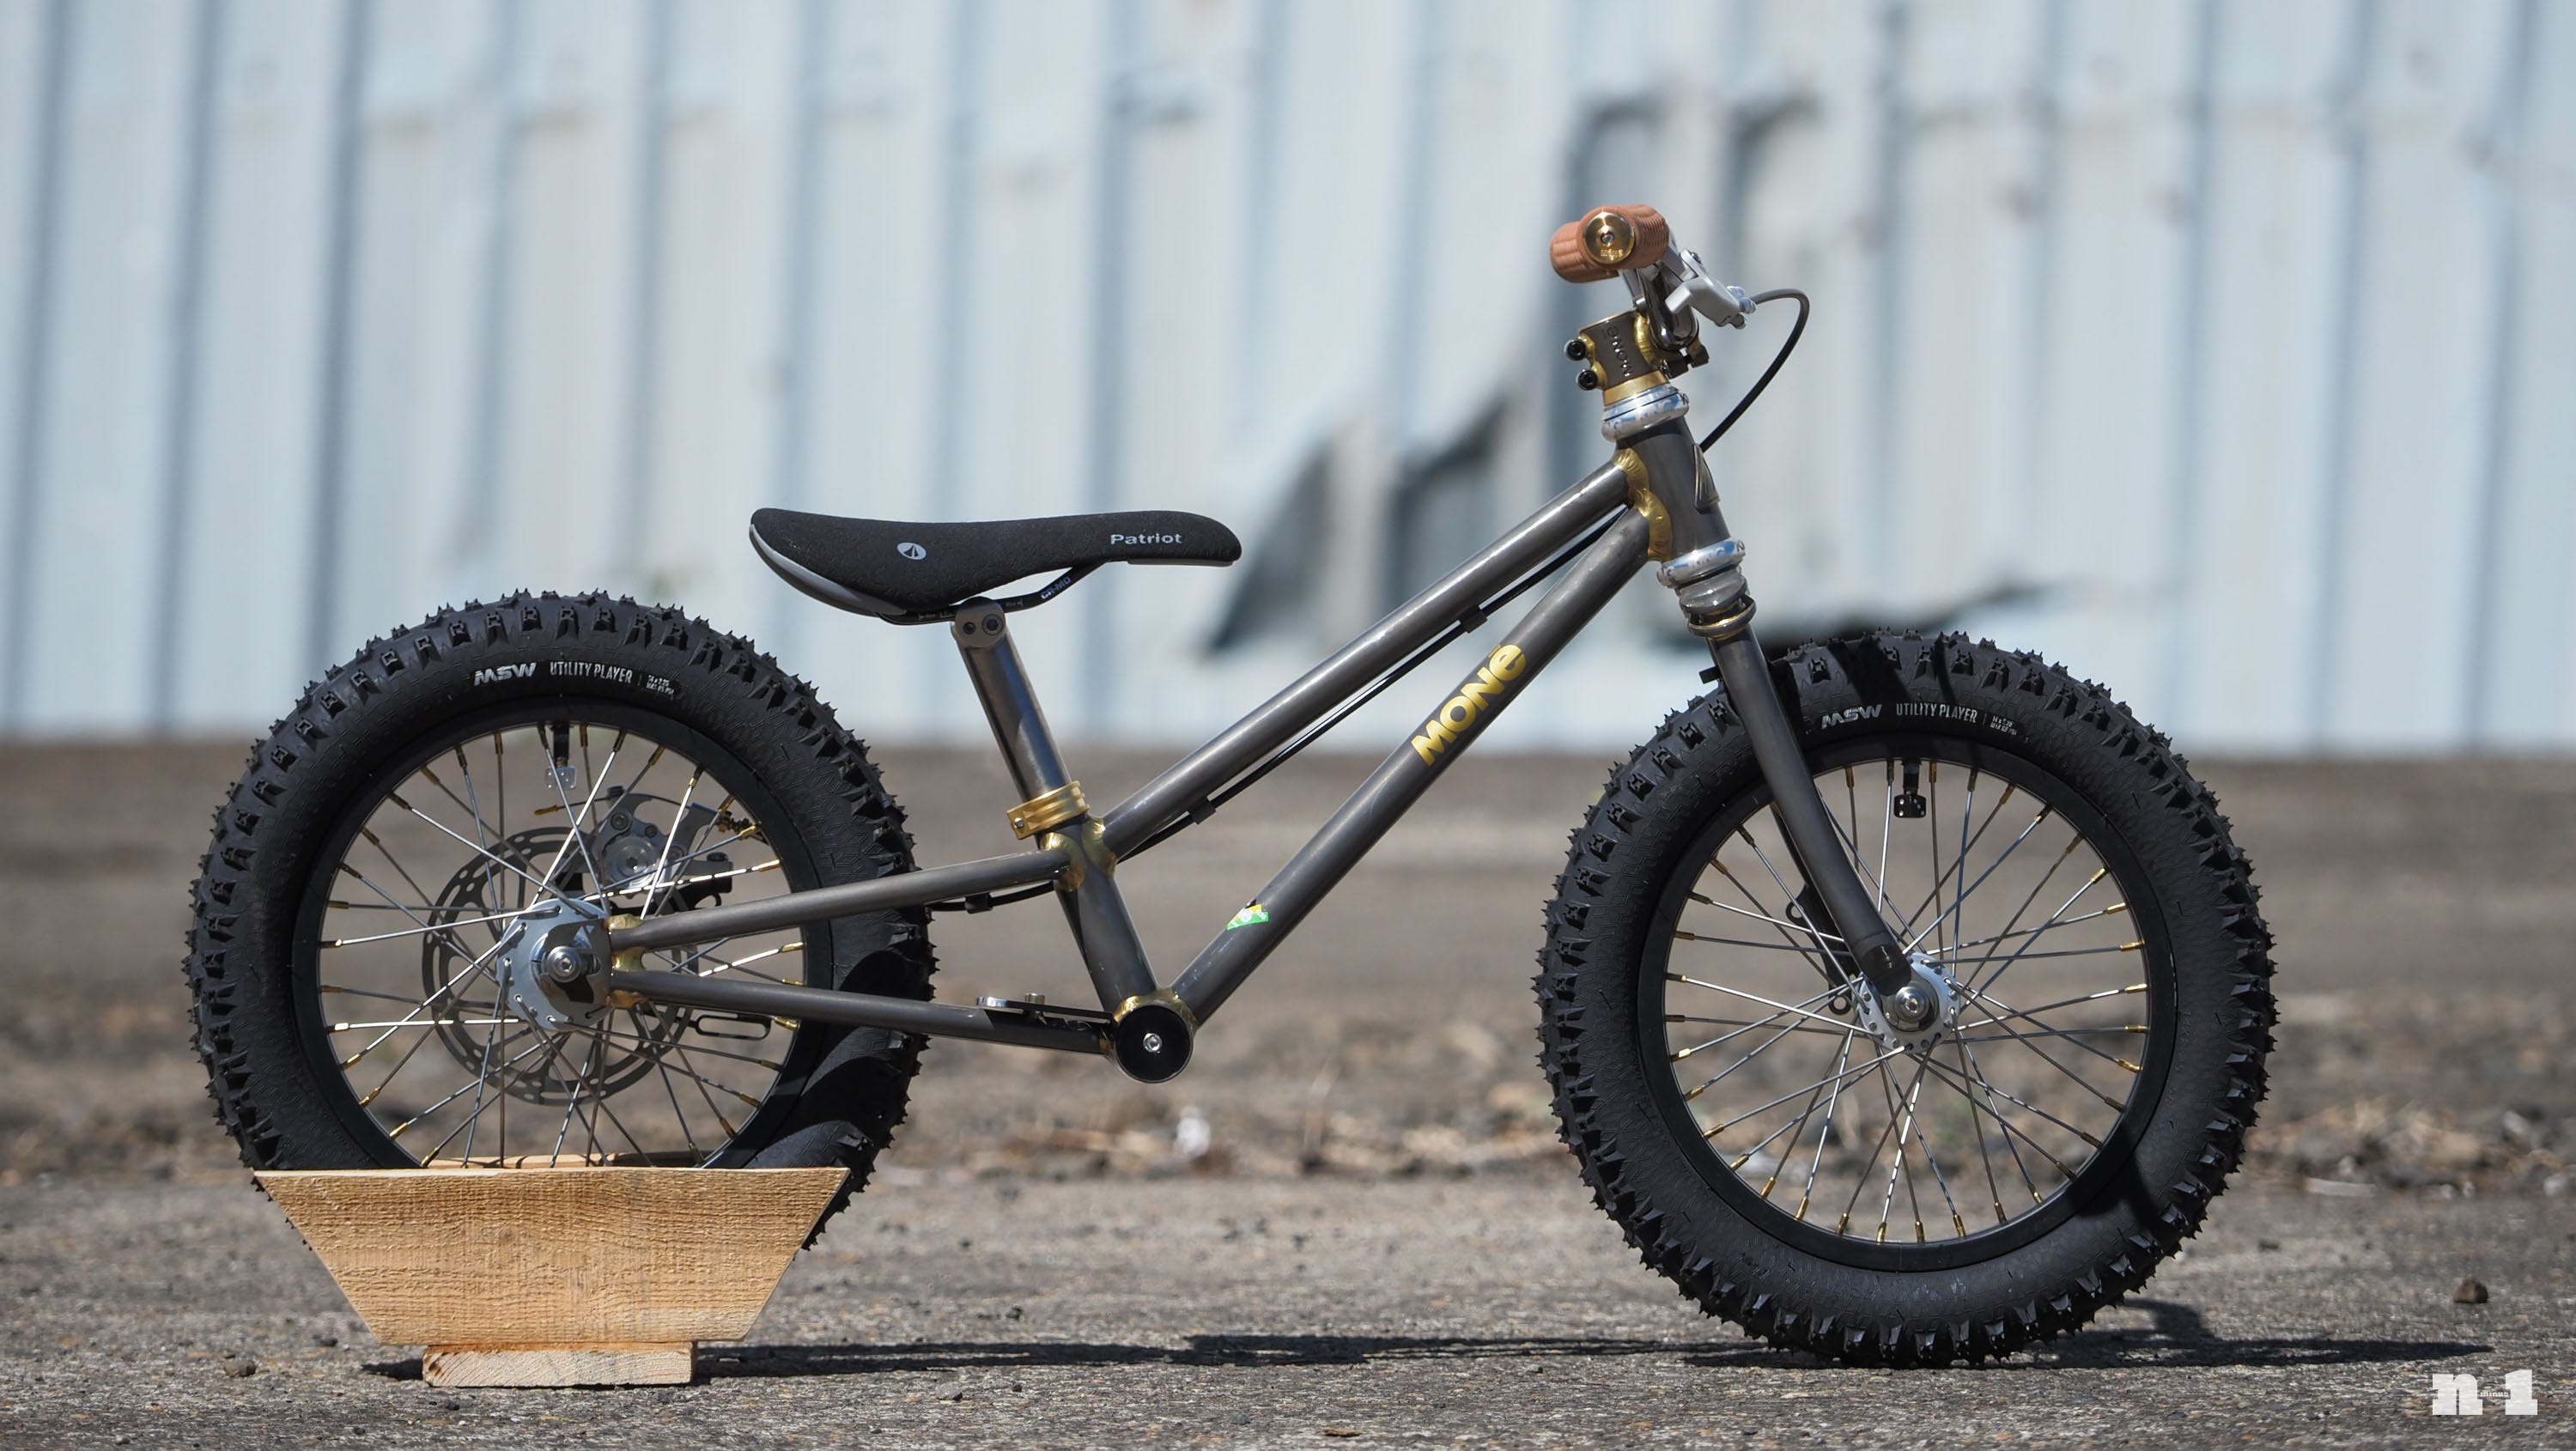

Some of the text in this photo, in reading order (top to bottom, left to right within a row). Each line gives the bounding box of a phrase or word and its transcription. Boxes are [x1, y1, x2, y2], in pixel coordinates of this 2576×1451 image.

[1110, 532, 1182, 545] Patriot
[1040, 576, 1072, 600] CR-MO
[473, 661, 633, 687] MSW UTILITY PLAYER
[1821, 702, 1978, 730] MSW UTILITY PLAYER
